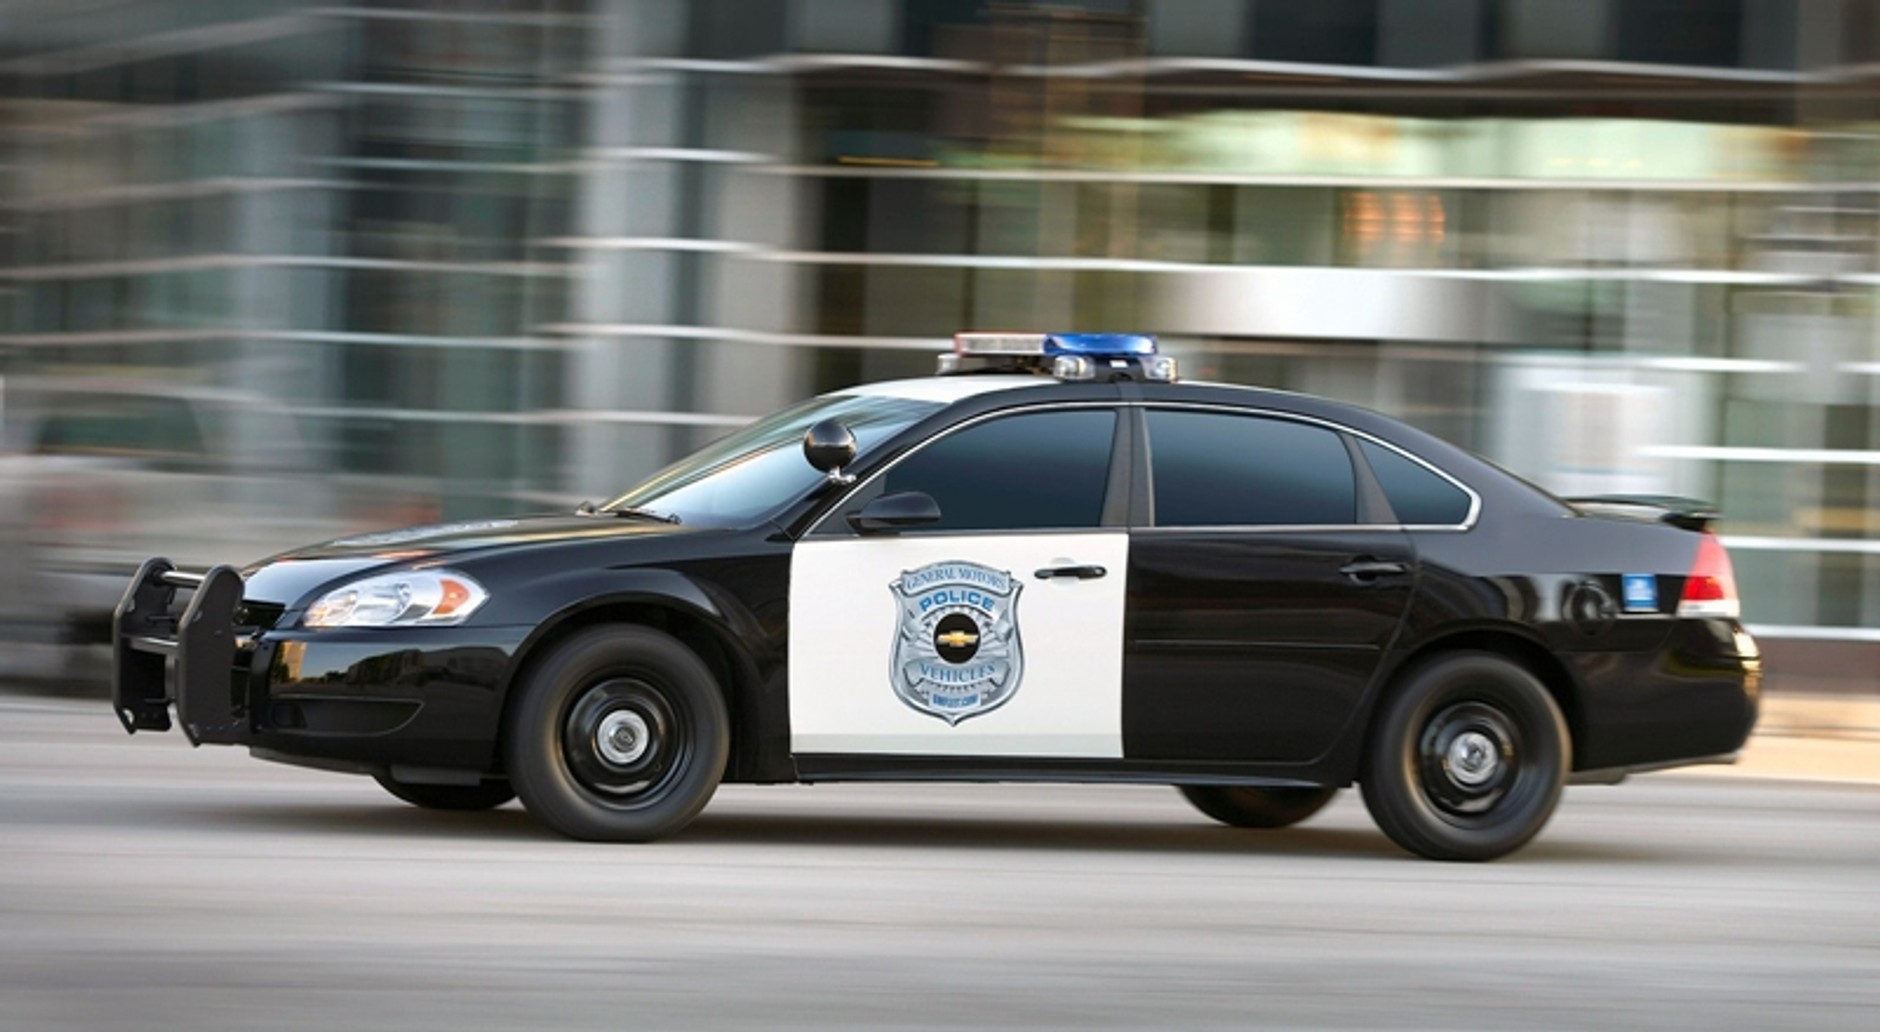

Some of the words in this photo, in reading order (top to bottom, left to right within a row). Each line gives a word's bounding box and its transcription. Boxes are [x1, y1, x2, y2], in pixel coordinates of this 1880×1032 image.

[907, 569, 957, 589] GENERAL
[958, 569, 1006, 588] MOTORS
[919, 590, 995, 611] POLICE
[920, 663, 995, 682] VEHICLES
